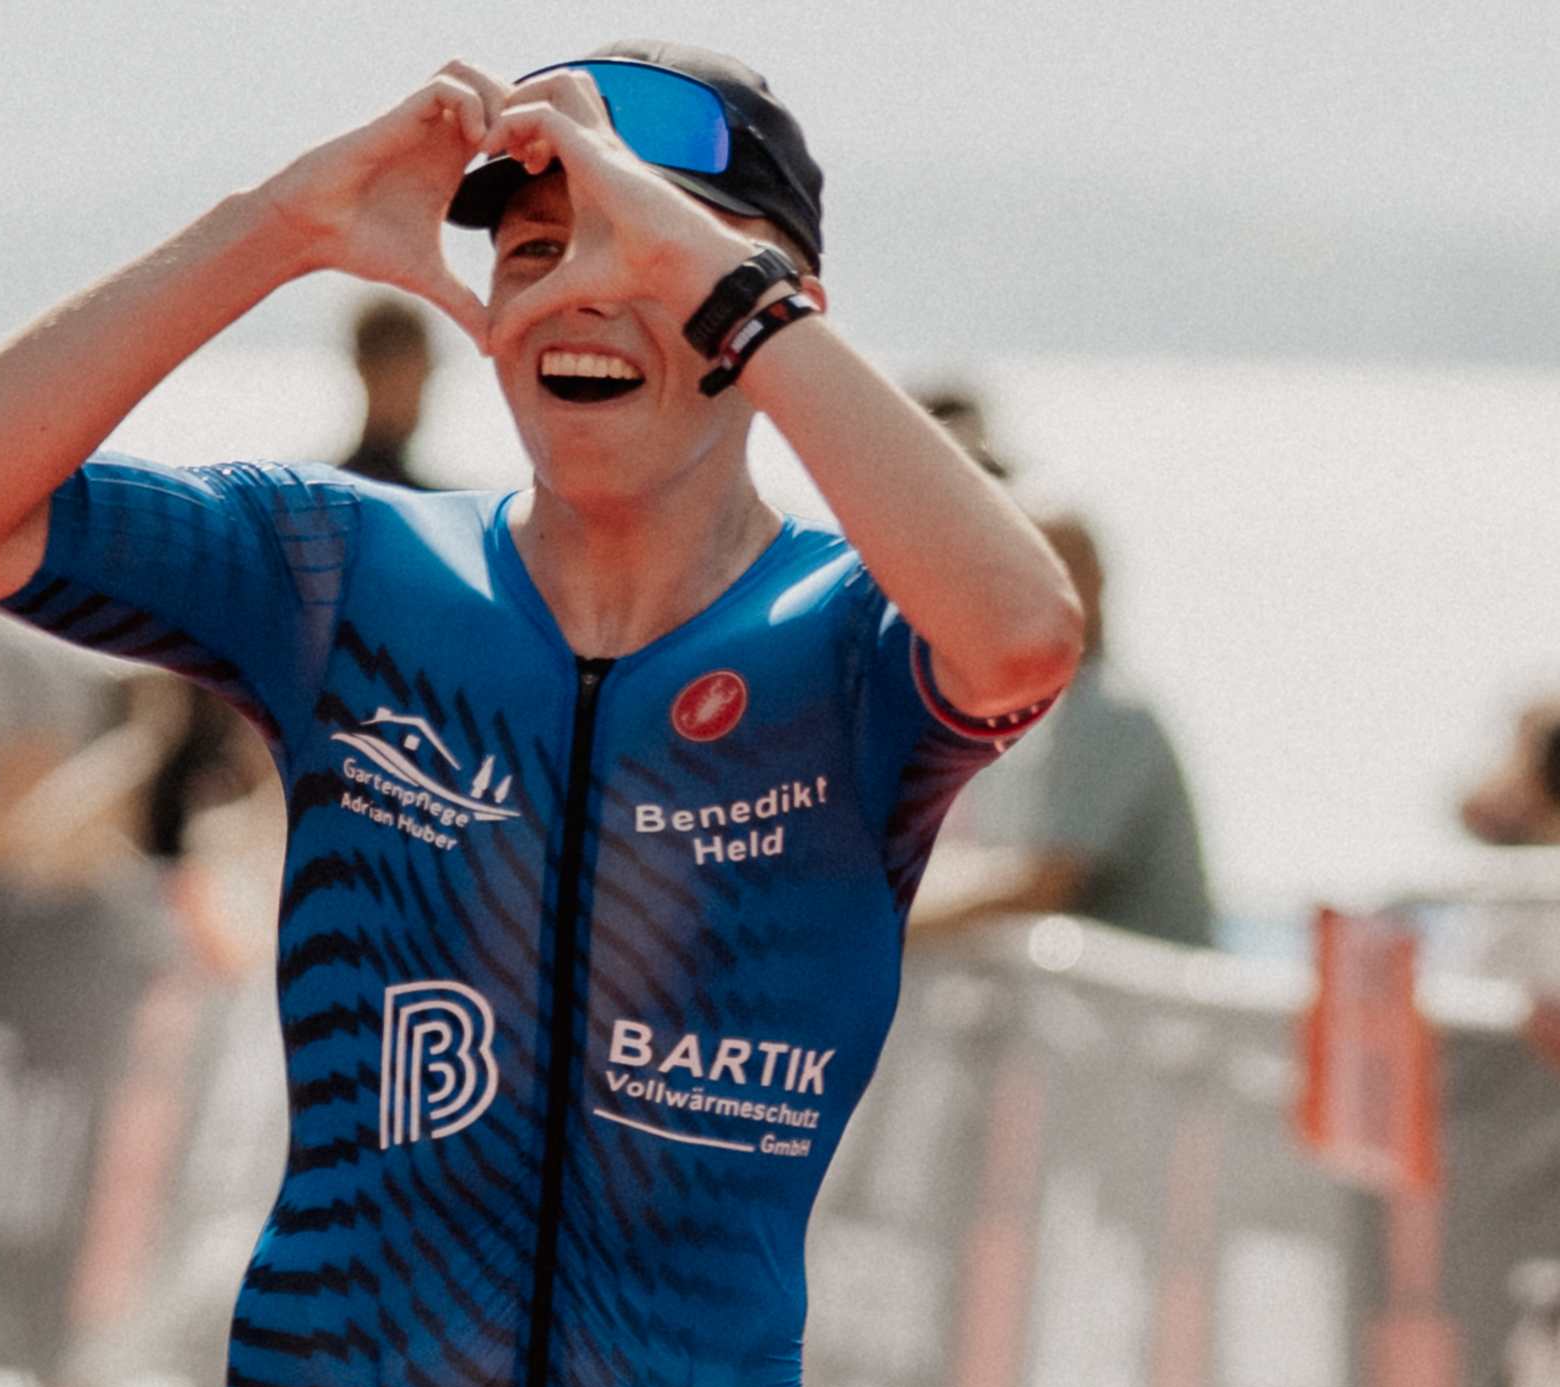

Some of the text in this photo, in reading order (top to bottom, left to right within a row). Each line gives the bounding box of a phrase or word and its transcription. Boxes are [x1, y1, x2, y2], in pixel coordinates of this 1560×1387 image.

[341, 791, 458, 851] Adrian Huber
[343, 757, 469, 828] Gartenpflege
[634, 775, 828, 834] Benedikt
[693, 825, 785, 866] Held
[608, 1018, 837, 1096] BARTIK
[605, 1069, 820, 1129] Vollwärmeschutz
[760, 1133, 812, 1158] GmbH
